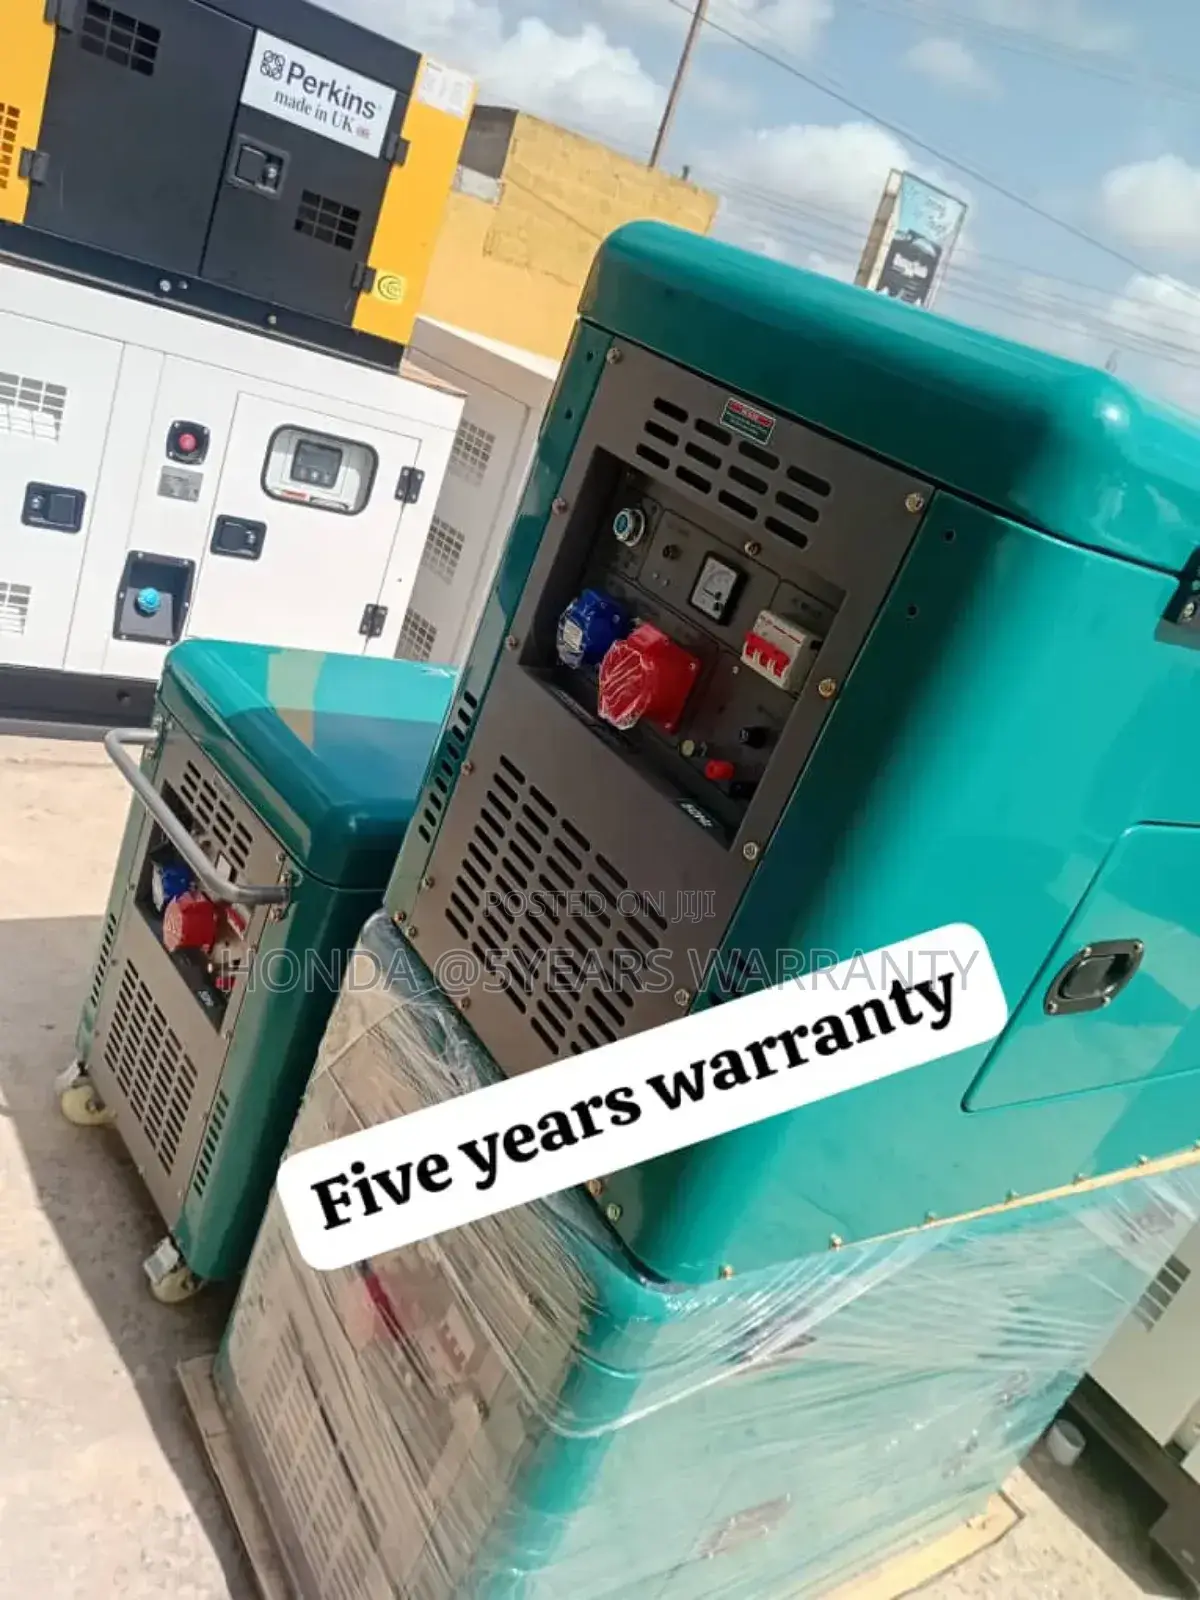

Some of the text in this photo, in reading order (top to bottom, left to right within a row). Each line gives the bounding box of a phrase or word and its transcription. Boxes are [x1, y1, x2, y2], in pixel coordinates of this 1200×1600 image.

[273, 89, 353, 133] made in UK
[286, 60, 376, 120] Perkins
